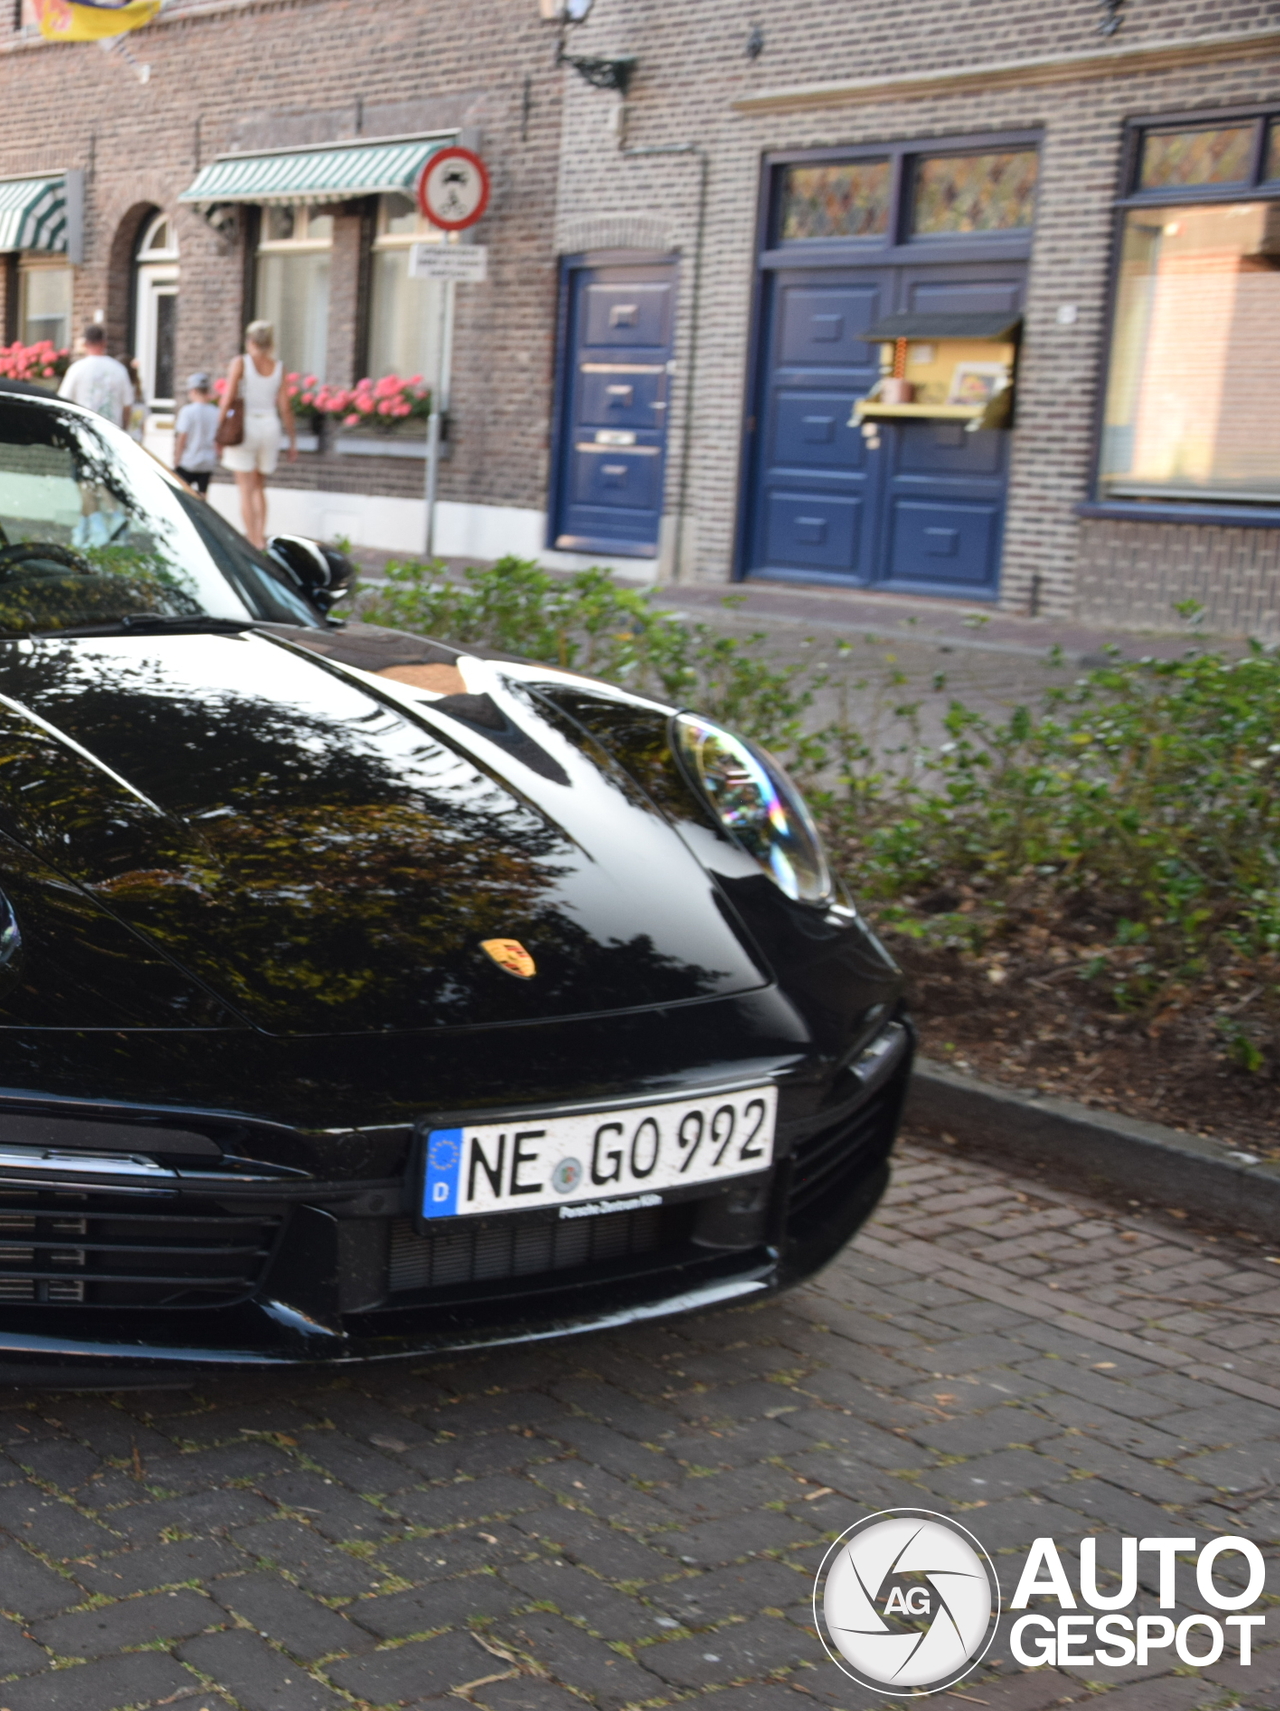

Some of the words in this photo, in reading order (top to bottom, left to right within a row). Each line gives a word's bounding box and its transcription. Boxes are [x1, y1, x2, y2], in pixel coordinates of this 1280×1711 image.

[466, 1129, 546, 1202] NE
[590, 1116, 660, 1187] GO
[677, 1097, 766, 1174] 992
[432, 1182, 450, 1203] D
